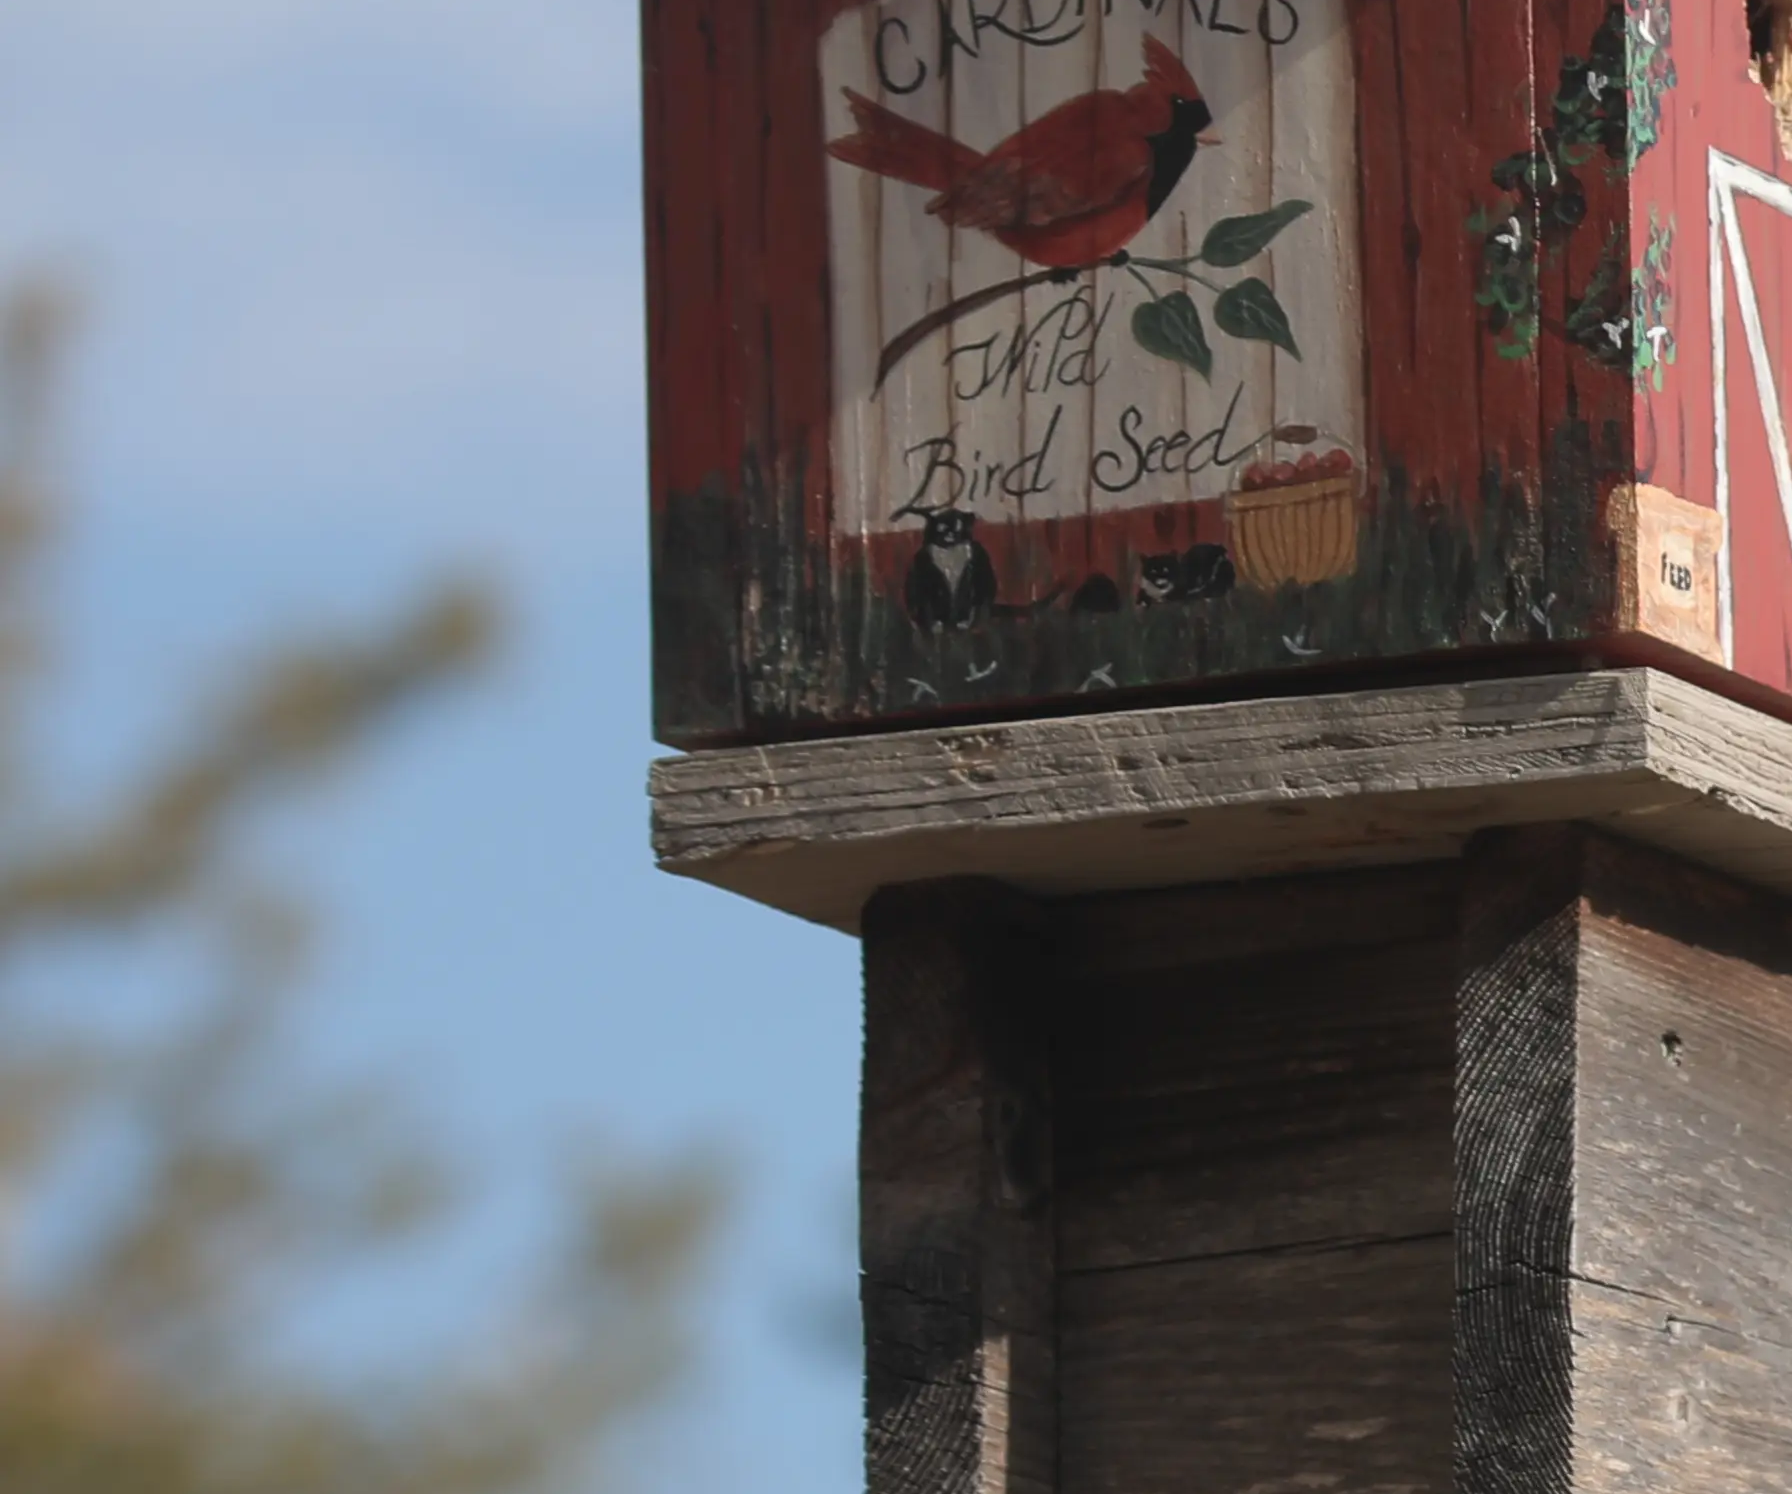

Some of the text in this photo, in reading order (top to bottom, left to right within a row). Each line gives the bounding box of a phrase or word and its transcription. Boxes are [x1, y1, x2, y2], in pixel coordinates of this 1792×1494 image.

[943, 284, 1115, 401] Wild
[890, 381, 1267, 522] Bird Seed
